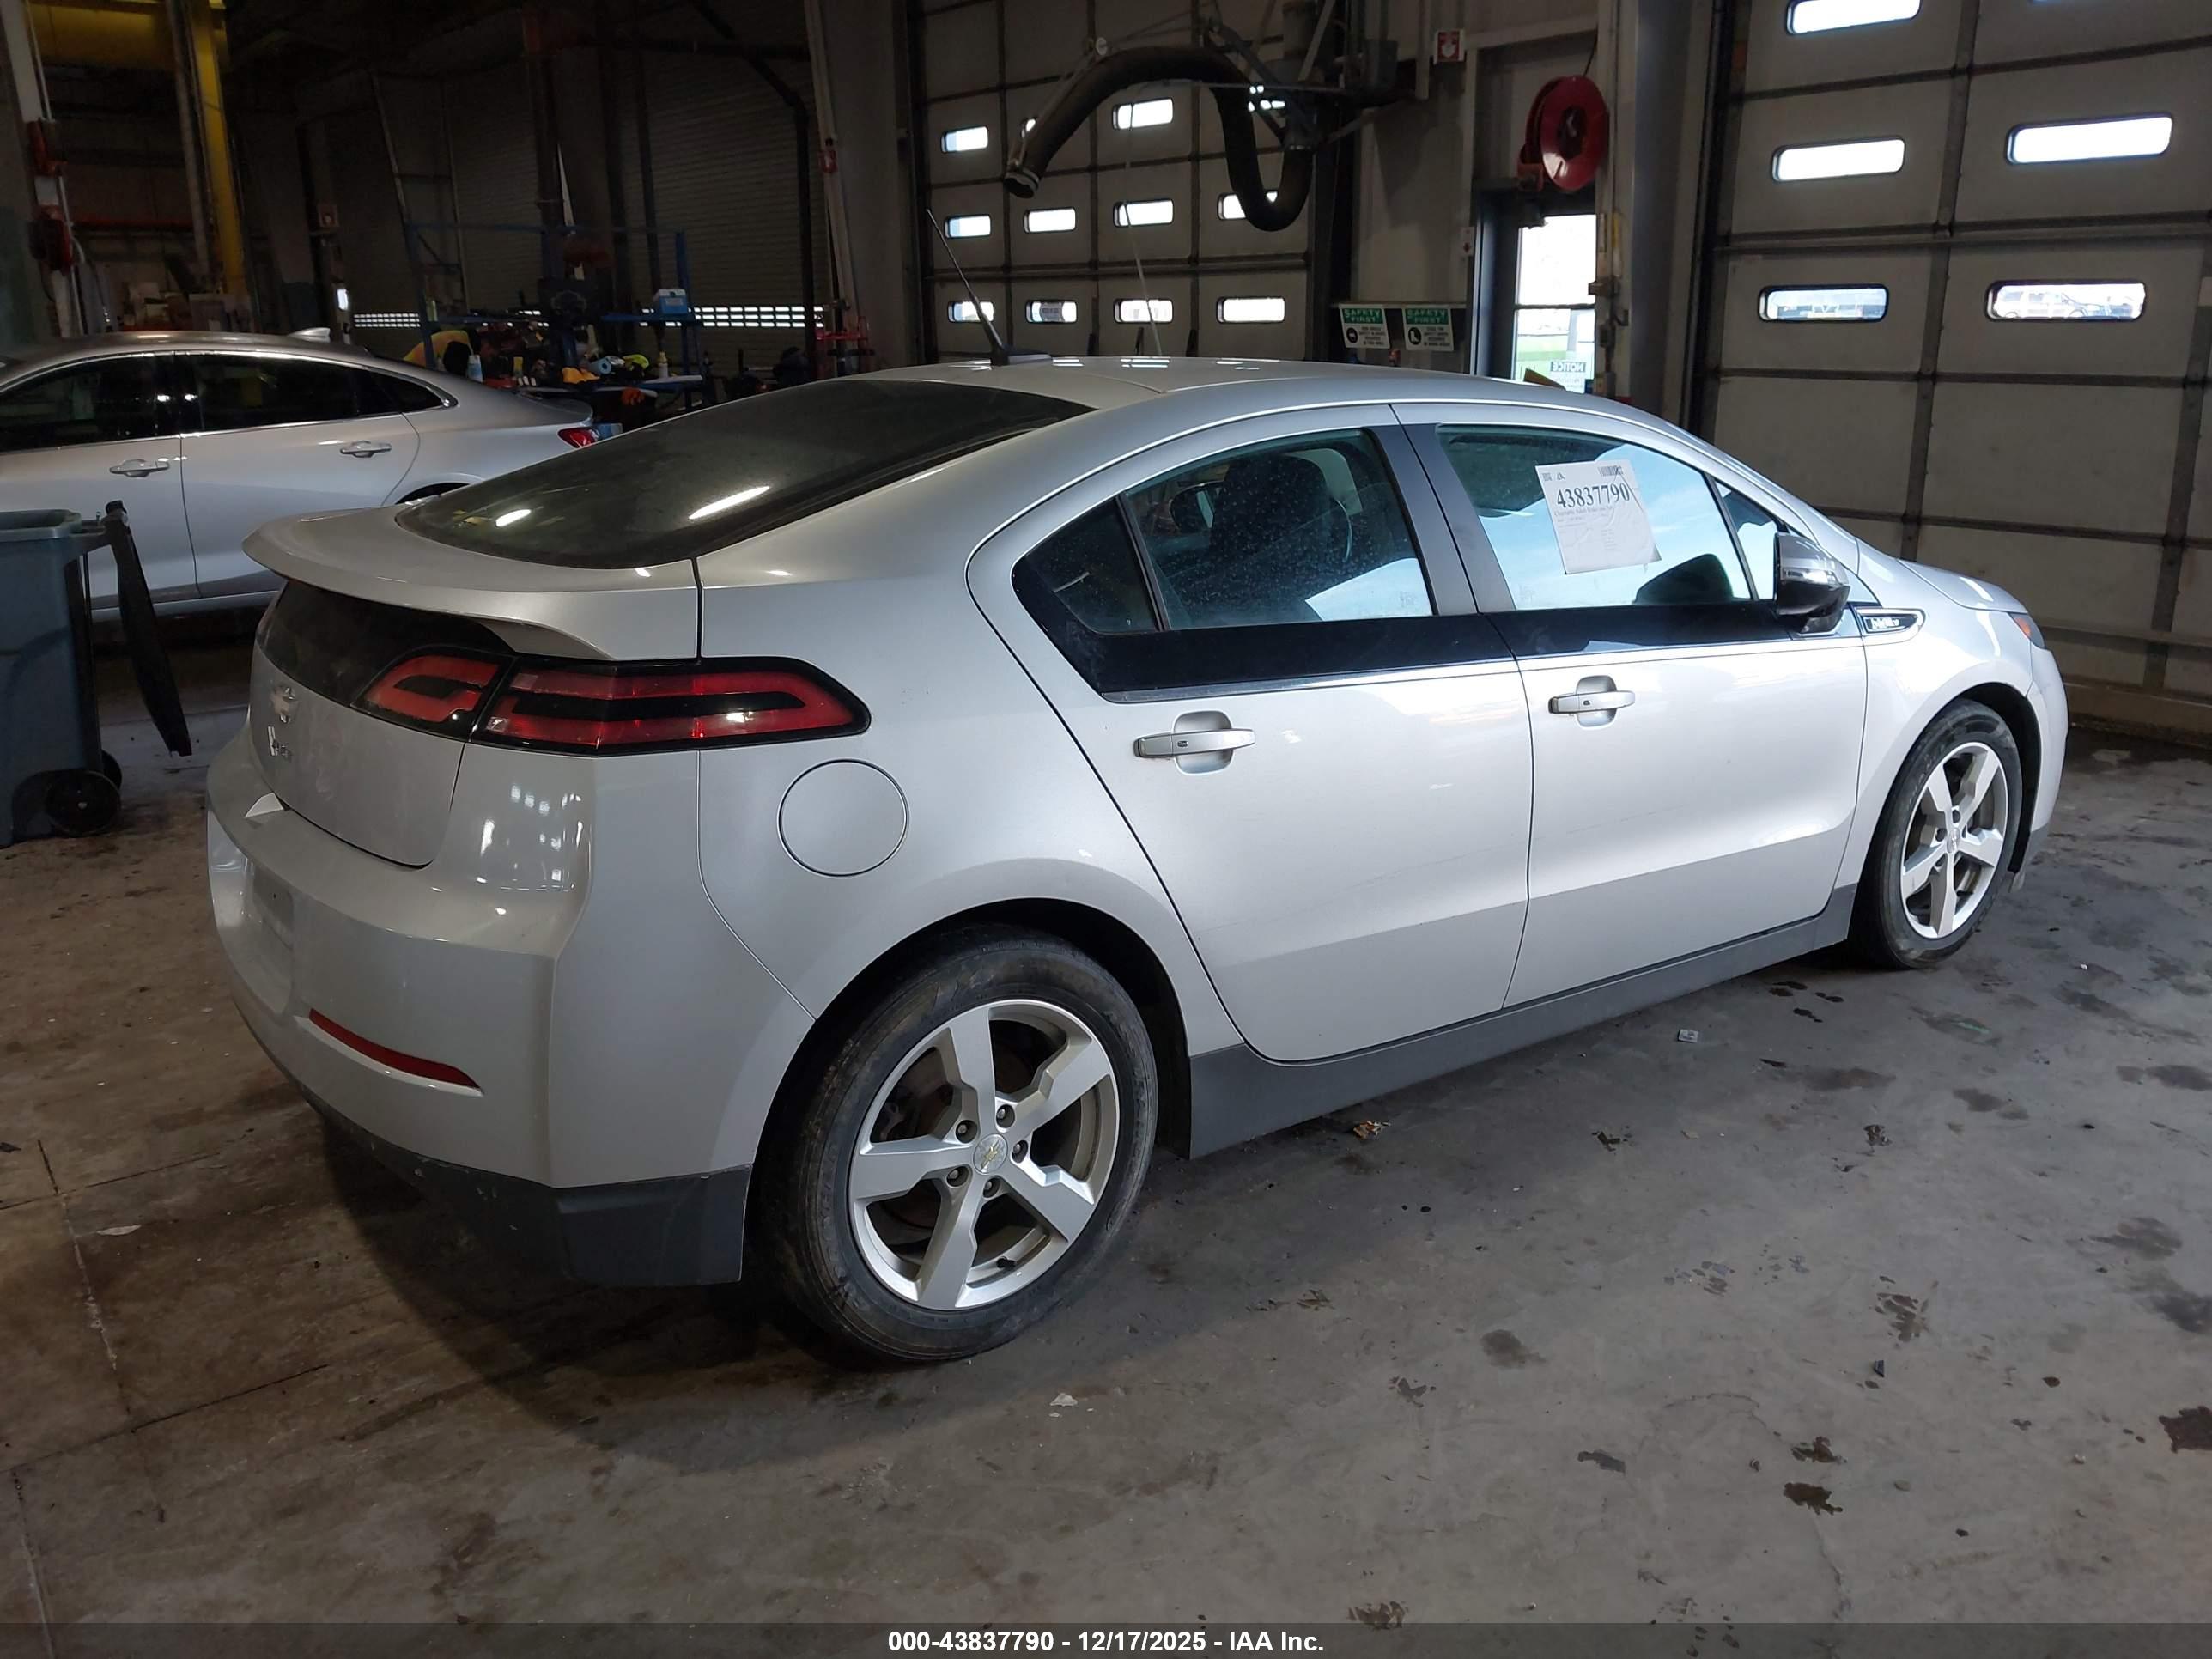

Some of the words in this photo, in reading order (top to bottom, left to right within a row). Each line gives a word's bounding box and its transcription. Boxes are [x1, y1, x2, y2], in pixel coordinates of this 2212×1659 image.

[1344, 308, 1380, 317] SAFETY
[1407, 309, 1444, 318] SAFETY
[1557, 483, 1630, 508] 43837790
